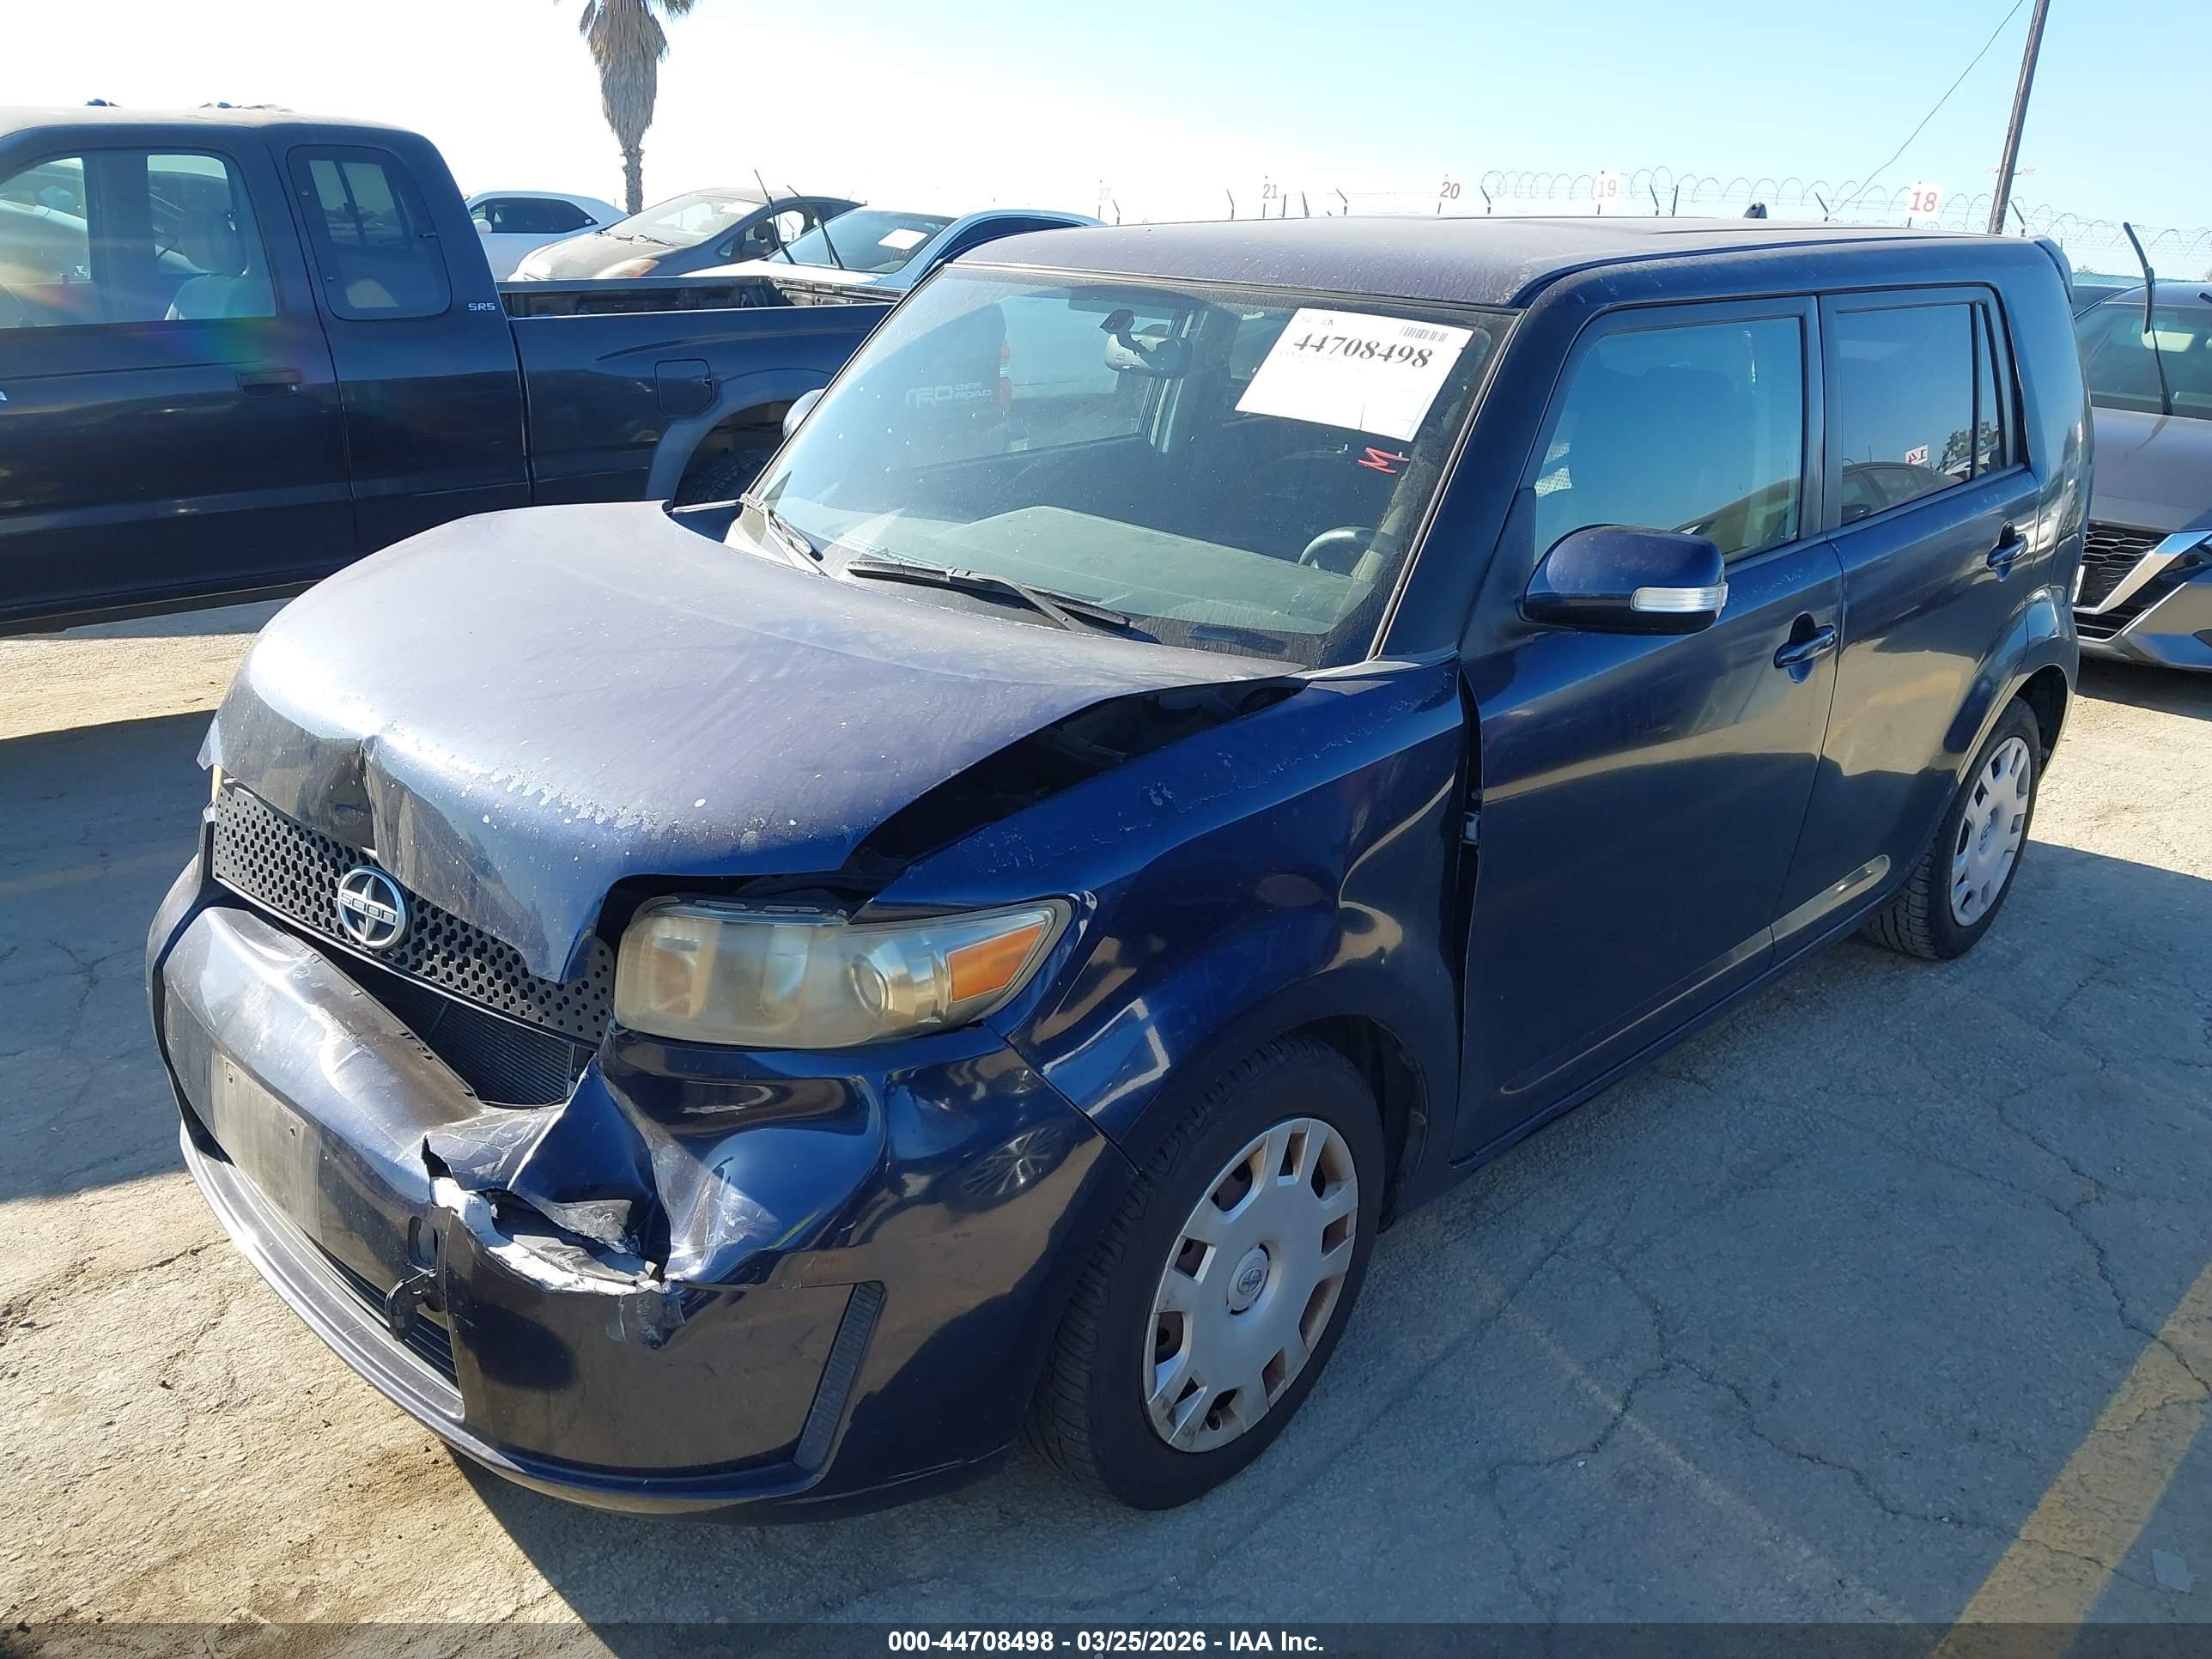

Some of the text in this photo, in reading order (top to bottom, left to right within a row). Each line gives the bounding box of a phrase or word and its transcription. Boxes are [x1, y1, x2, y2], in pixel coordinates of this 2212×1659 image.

[1262, 184, 1278, 199] 21
[1439, 181, 1461, 199] 20
[1597, 179, 1616, 198] 19
[1909, 191, 1937, 212] 18
[468, 302, 495, 311] SR5
[1294, 333, 1433, 368] 44708498
[955, 389, 992, 398] ROAD
